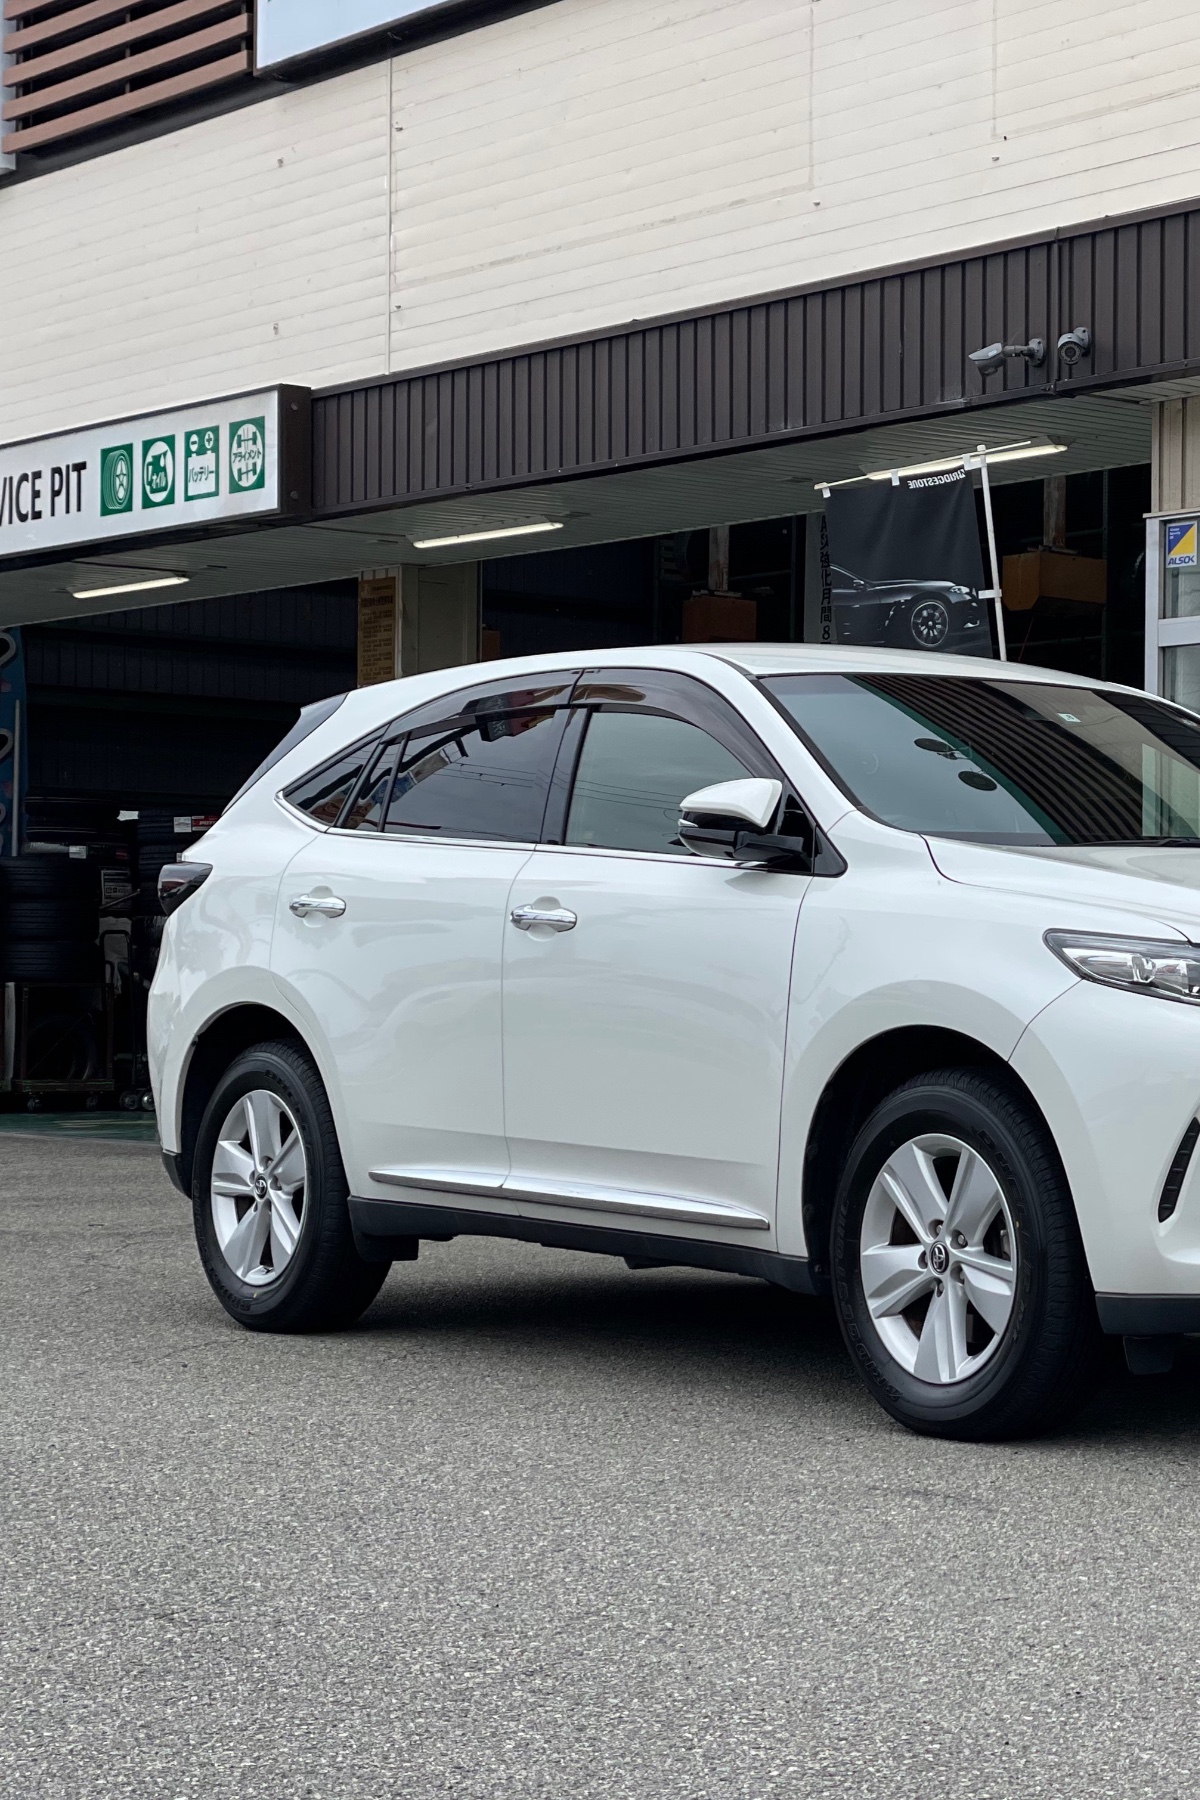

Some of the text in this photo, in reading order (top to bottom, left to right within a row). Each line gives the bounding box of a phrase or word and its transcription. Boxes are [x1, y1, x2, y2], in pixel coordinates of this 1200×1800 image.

[233, 448, 261, 463] アライメント
[152, 470, 167, 489] オイル
[188, 465, 215, 483] バッテリー
[50, 460, 87, 517] PIT
[1167, 555, 1196, 566] ALSOK
